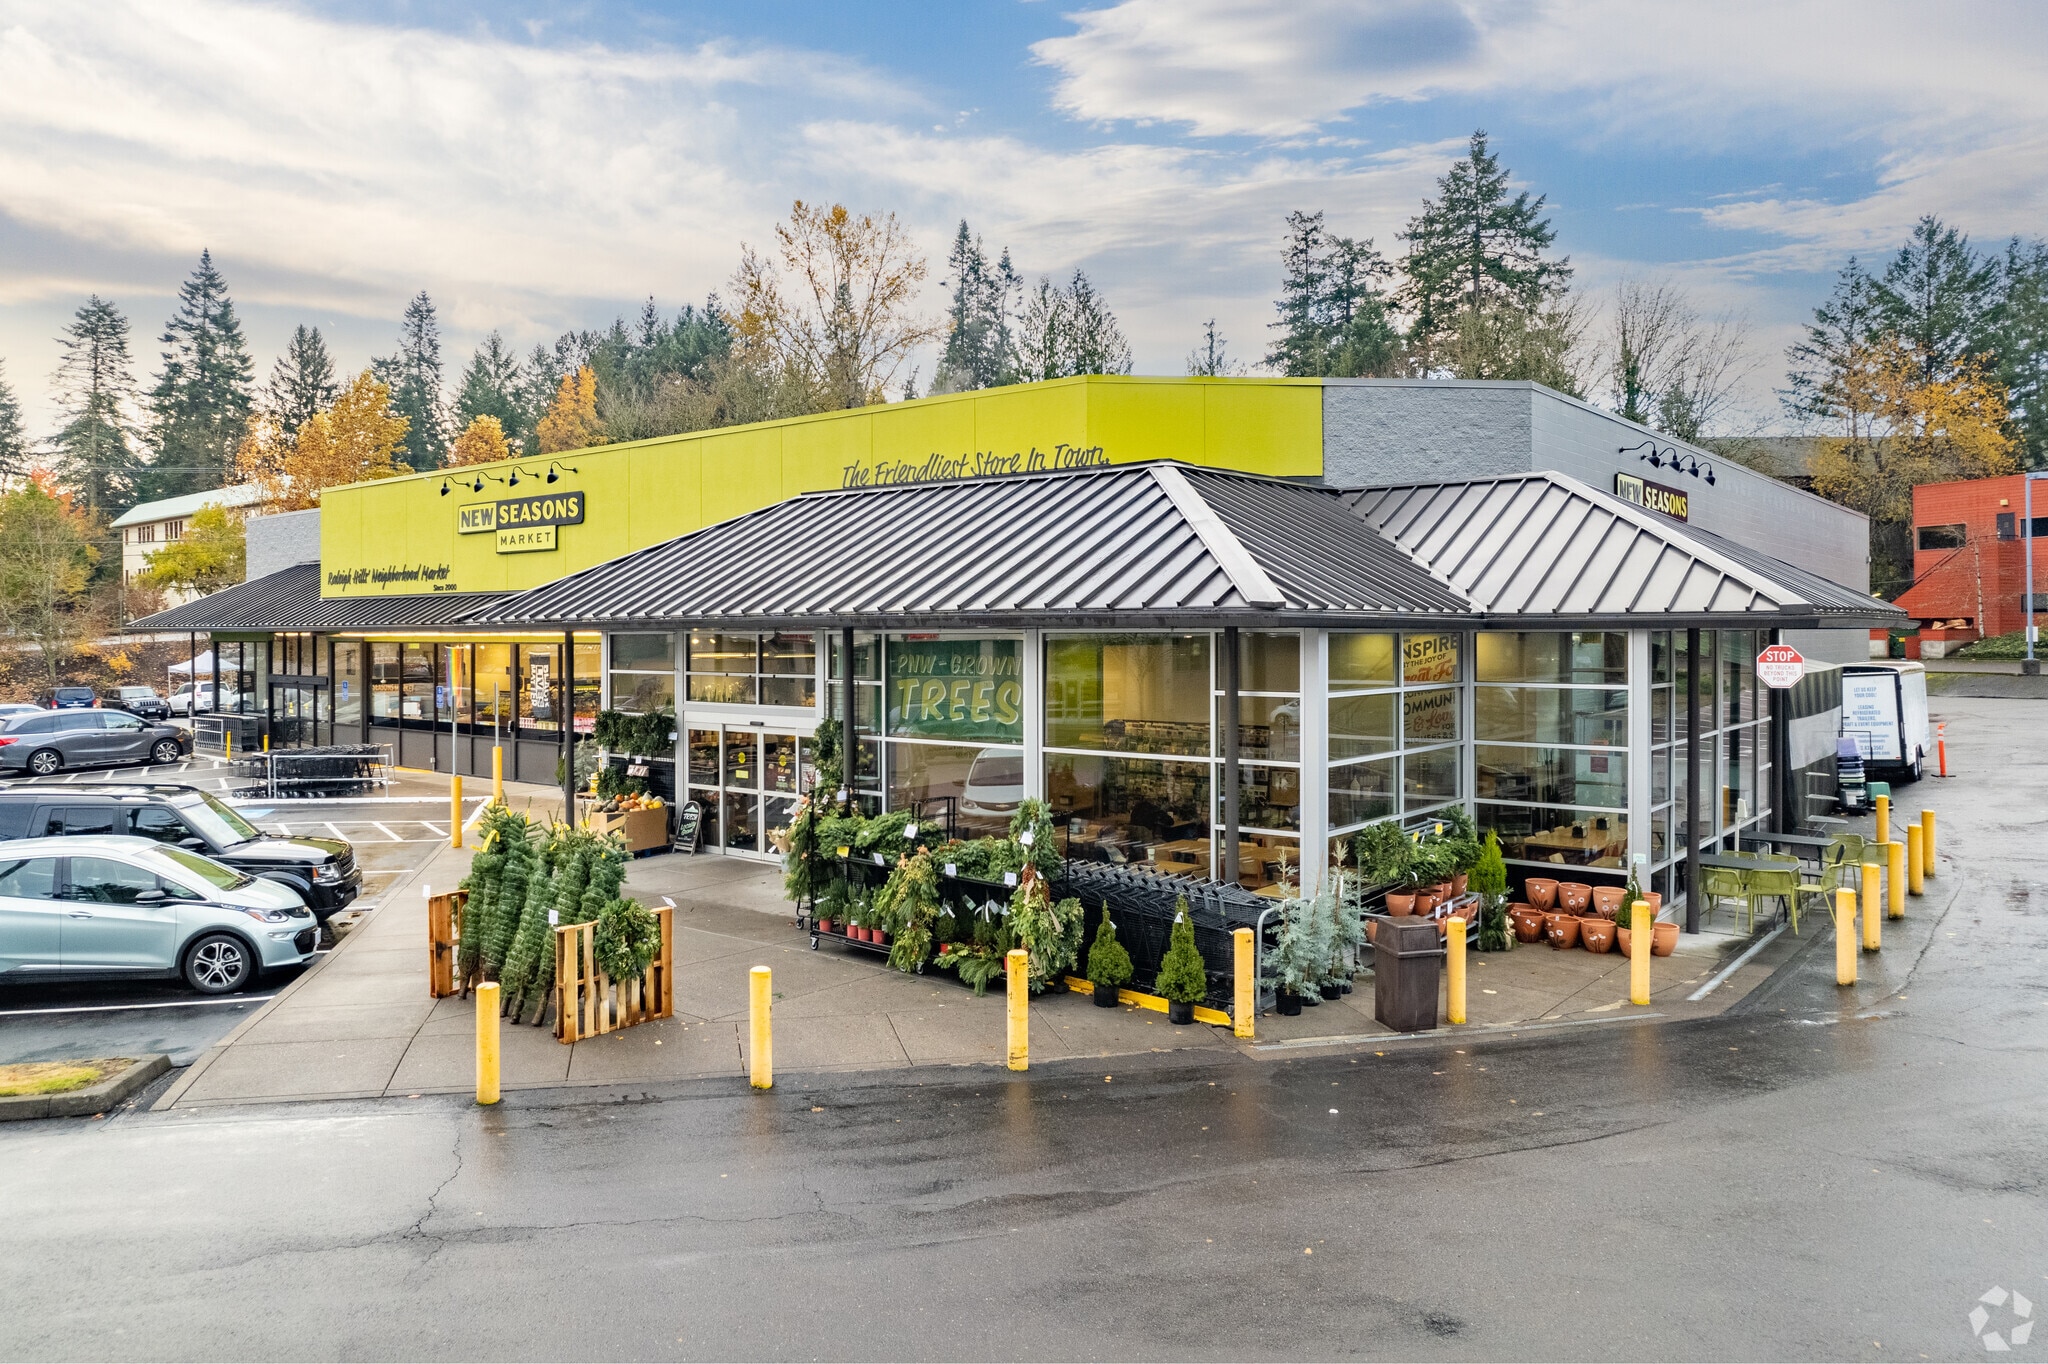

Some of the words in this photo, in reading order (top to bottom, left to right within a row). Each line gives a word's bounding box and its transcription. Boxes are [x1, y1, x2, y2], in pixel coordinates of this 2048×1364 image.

[842, 459, 870, 488] The
[874, 452, 969, 485] Friendliest
[971, 450, 1022, 477] Store
[1026, 447, 1047, 472] In
[461, 506, 494, 528] NEW
[499, 497, 579, 524] SEASONS
[1619, 479, 1642, 504] NEW
[1645, 486, 1687, 518] SEASONS
[500, 531, 551, 546] MARKET
[328, 568, 351, 592] Raleigh
[371, 564, 421, 591] Neighborhood
[421, 563, 450, 582] Market
[433, 584, 444, 592] Since
[445, 583, 457, 591] 2000
[1411, 659, 1424, 667] THE
[1424, 655, 1436, 665] JOY
[1437, 653, 1447, 661] OF
[1766, 650, 1795, 662] STOP
[536, 665, 545, 708] LIVES
[896, 678, 1022, 725] TREES
